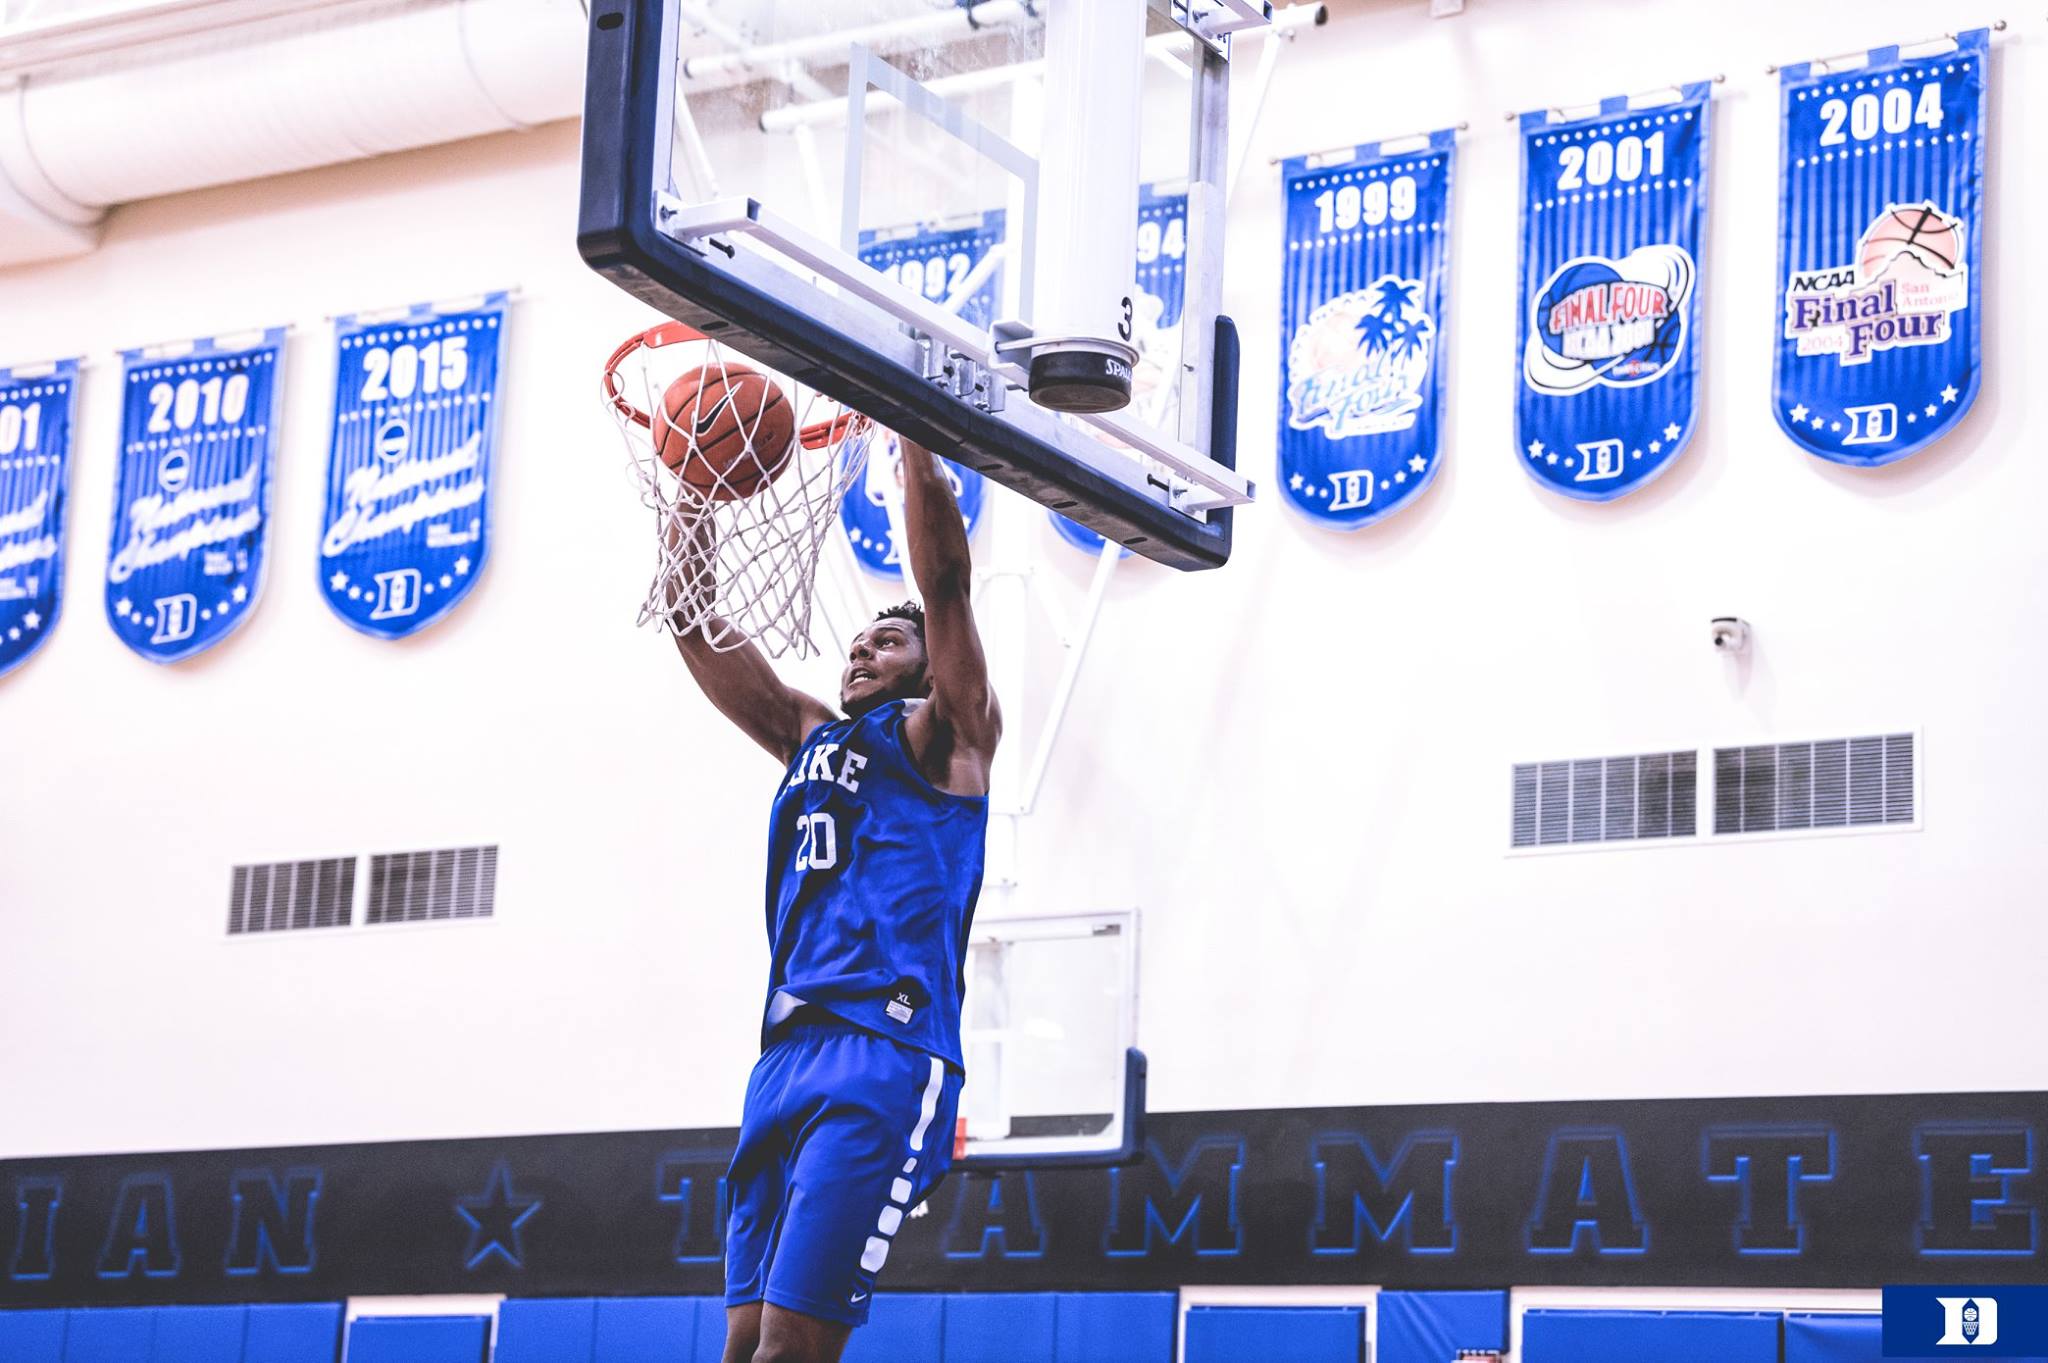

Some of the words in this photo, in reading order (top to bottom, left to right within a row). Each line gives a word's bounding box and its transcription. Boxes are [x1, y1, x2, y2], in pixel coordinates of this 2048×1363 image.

[1819, 82, 1944, 147] 2004
[1557, 130, 1665, 190] 2001
[1314, 176, 1417, 233] 1999
[1793, 270, 1855, 291] NCAA
[1794, 284, 1895, 329] Final
[1118, 297, 1133, 342] 3
[1552, 286, 1608, 331] FINAL
[1611, 284, 1666, 322] FOUR
[1802, 335, 1844, 352] 2004
[1849, 313, 1943, 356] Four
[361, 336, 468, 401] 2015
[0, 402, 41, 454] 01
[148, 374, 249, 433] 2010
[780, 743, 868, 796] UKE
[795, 812, 838, 872] 20
[896, 992, 911, 1006] XL
[9, 1164, 323, 1282] IAN
[655, 1118, 2040, 1263] TAMMATE
